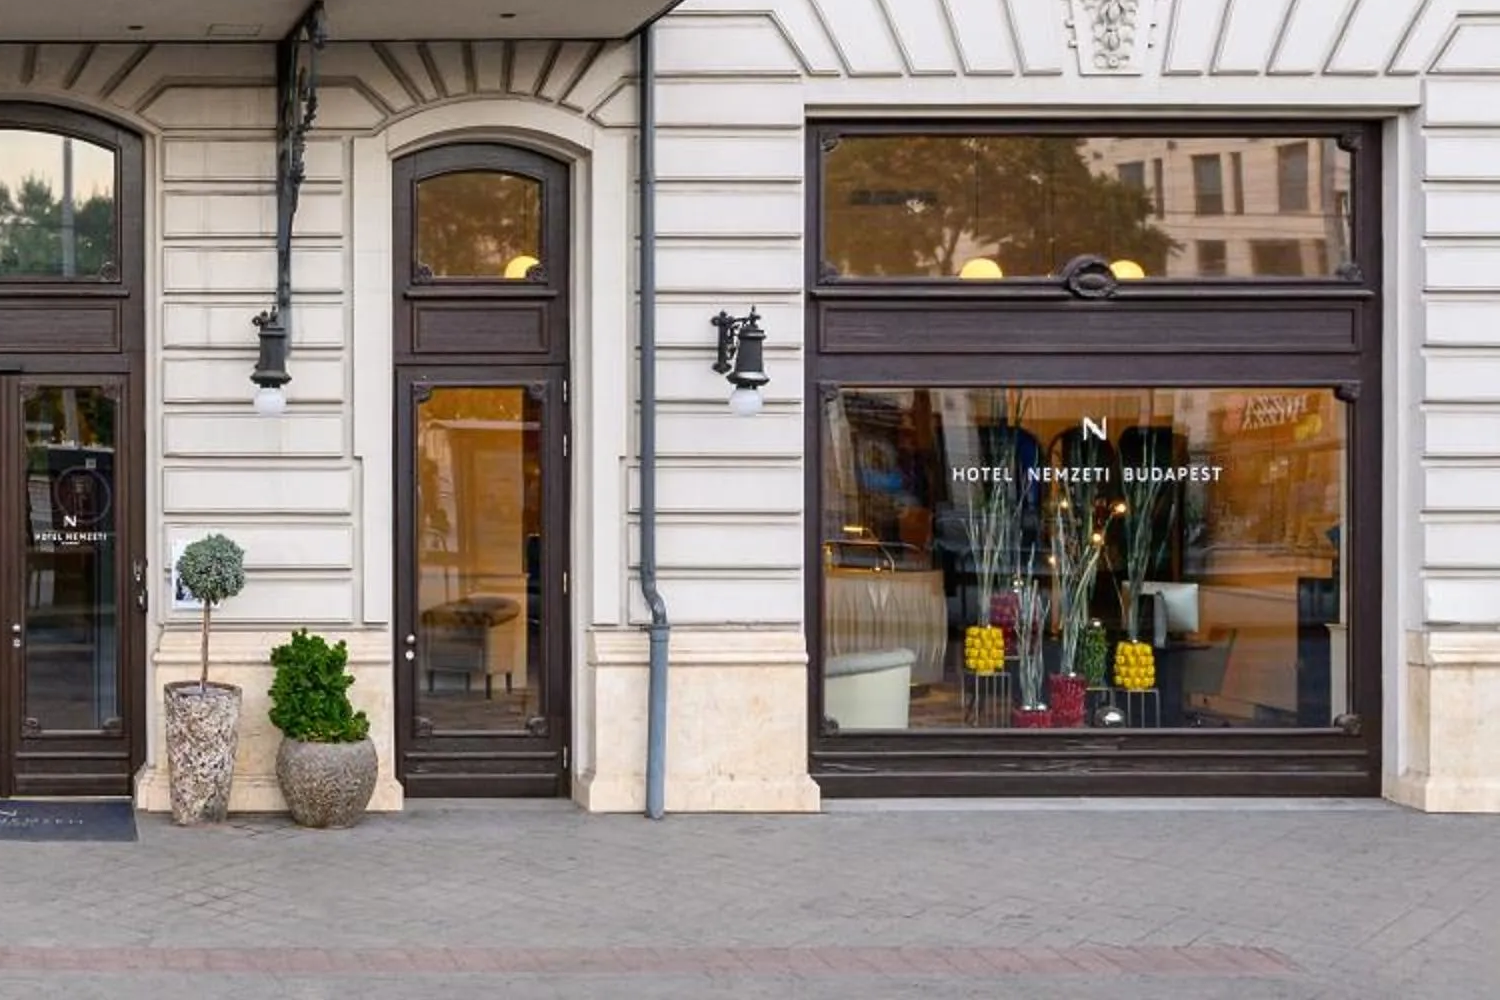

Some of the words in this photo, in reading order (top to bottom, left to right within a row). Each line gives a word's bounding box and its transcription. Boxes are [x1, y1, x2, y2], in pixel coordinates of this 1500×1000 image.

[1082, 415, 1108, 441] N
[952, 466, 1013, 482] HOTEL
[1027, 466, 1110, 482] NEMZETI
[1123, 466, 1223, 482] BUDAPEST
[63, 514, 77, 528] N
